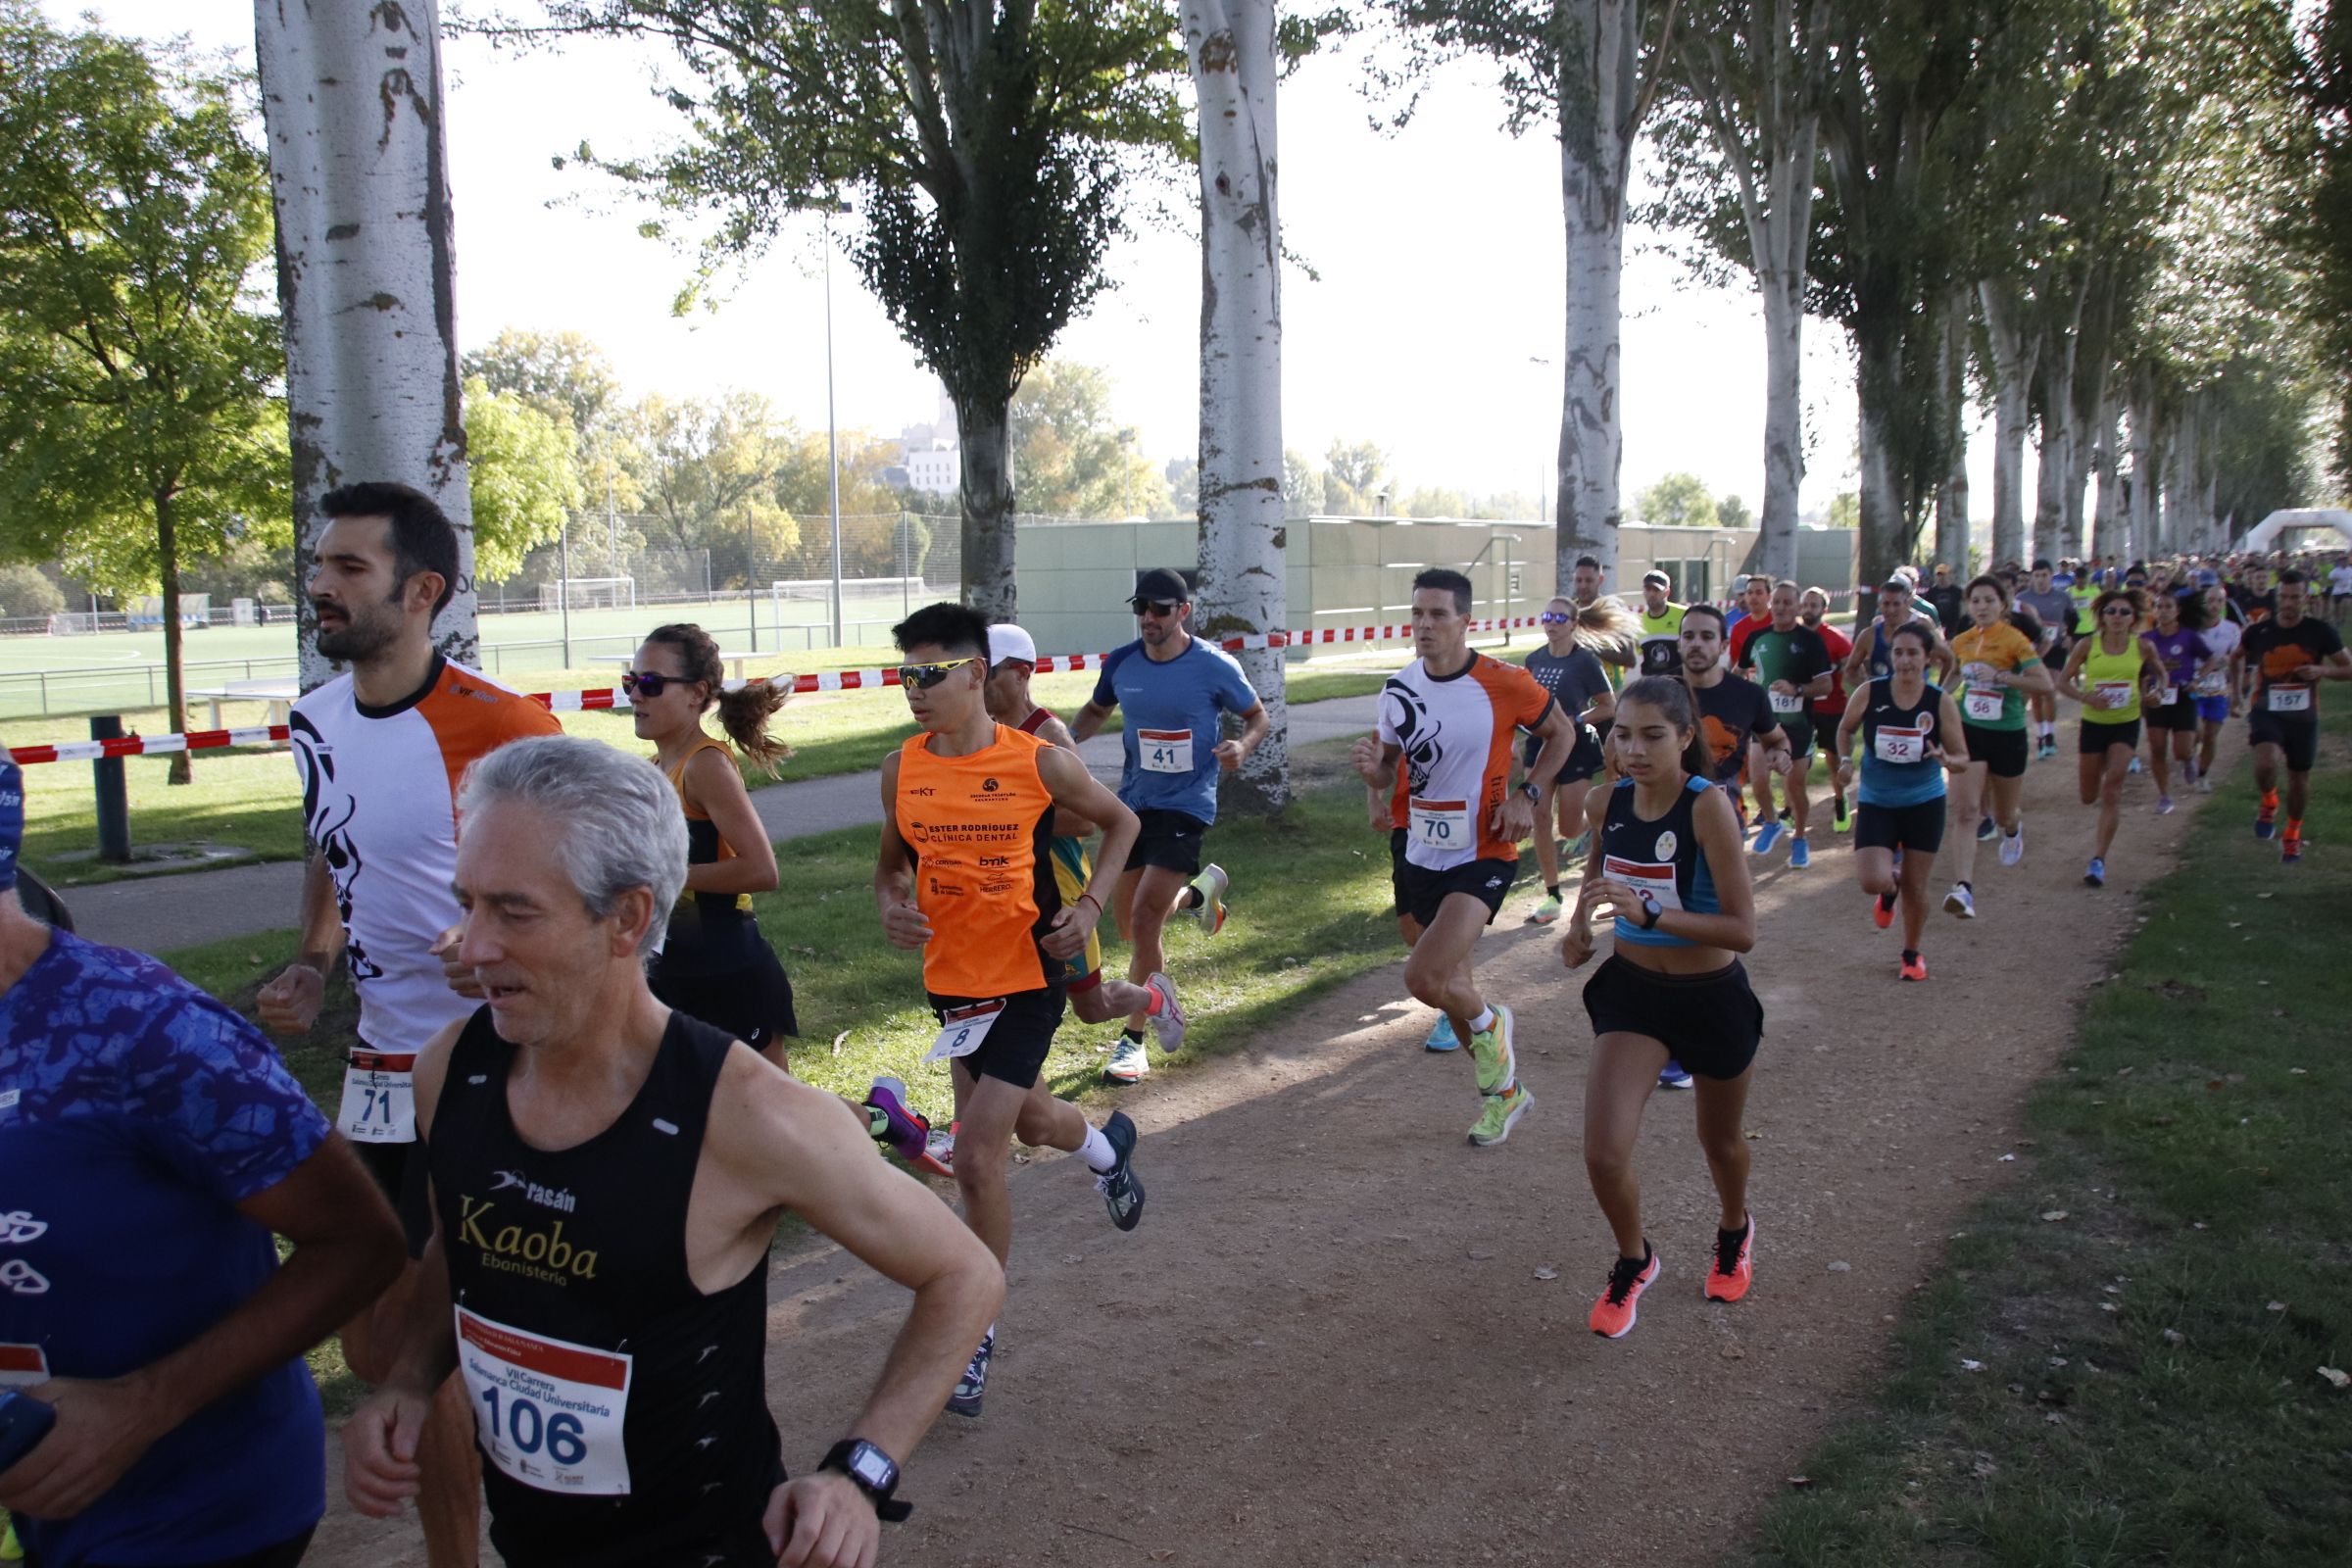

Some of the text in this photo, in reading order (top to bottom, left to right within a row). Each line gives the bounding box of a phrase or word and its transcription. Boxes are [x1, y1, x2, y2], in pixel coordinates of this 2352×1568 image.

[1774, 697, 1795, 708] 181
[1152, 748, 1174, 764] 41
[1887, 742, 1909, 757] 32
[929, 823, 1019, 833] ESTER RODRÍGUEZ
[930, 832, 1018, 843] CLÍNICA DENTAL
[1424, 819, 1450, 839] 70
[952, 1028, 970, 1048] 8
[362, 1089, 390, 1124] 71
[526, 1181, 576, 1213] rasán
[459, 1194, 598, 1280] Kaoba
[506, 1366, 556, 1393] VII Carrera
[510, 1379, 541, 1399] Ciudad
[543, 1391, 610, 1418] Universitaria
[482, 1385, 587, 1465] 106
